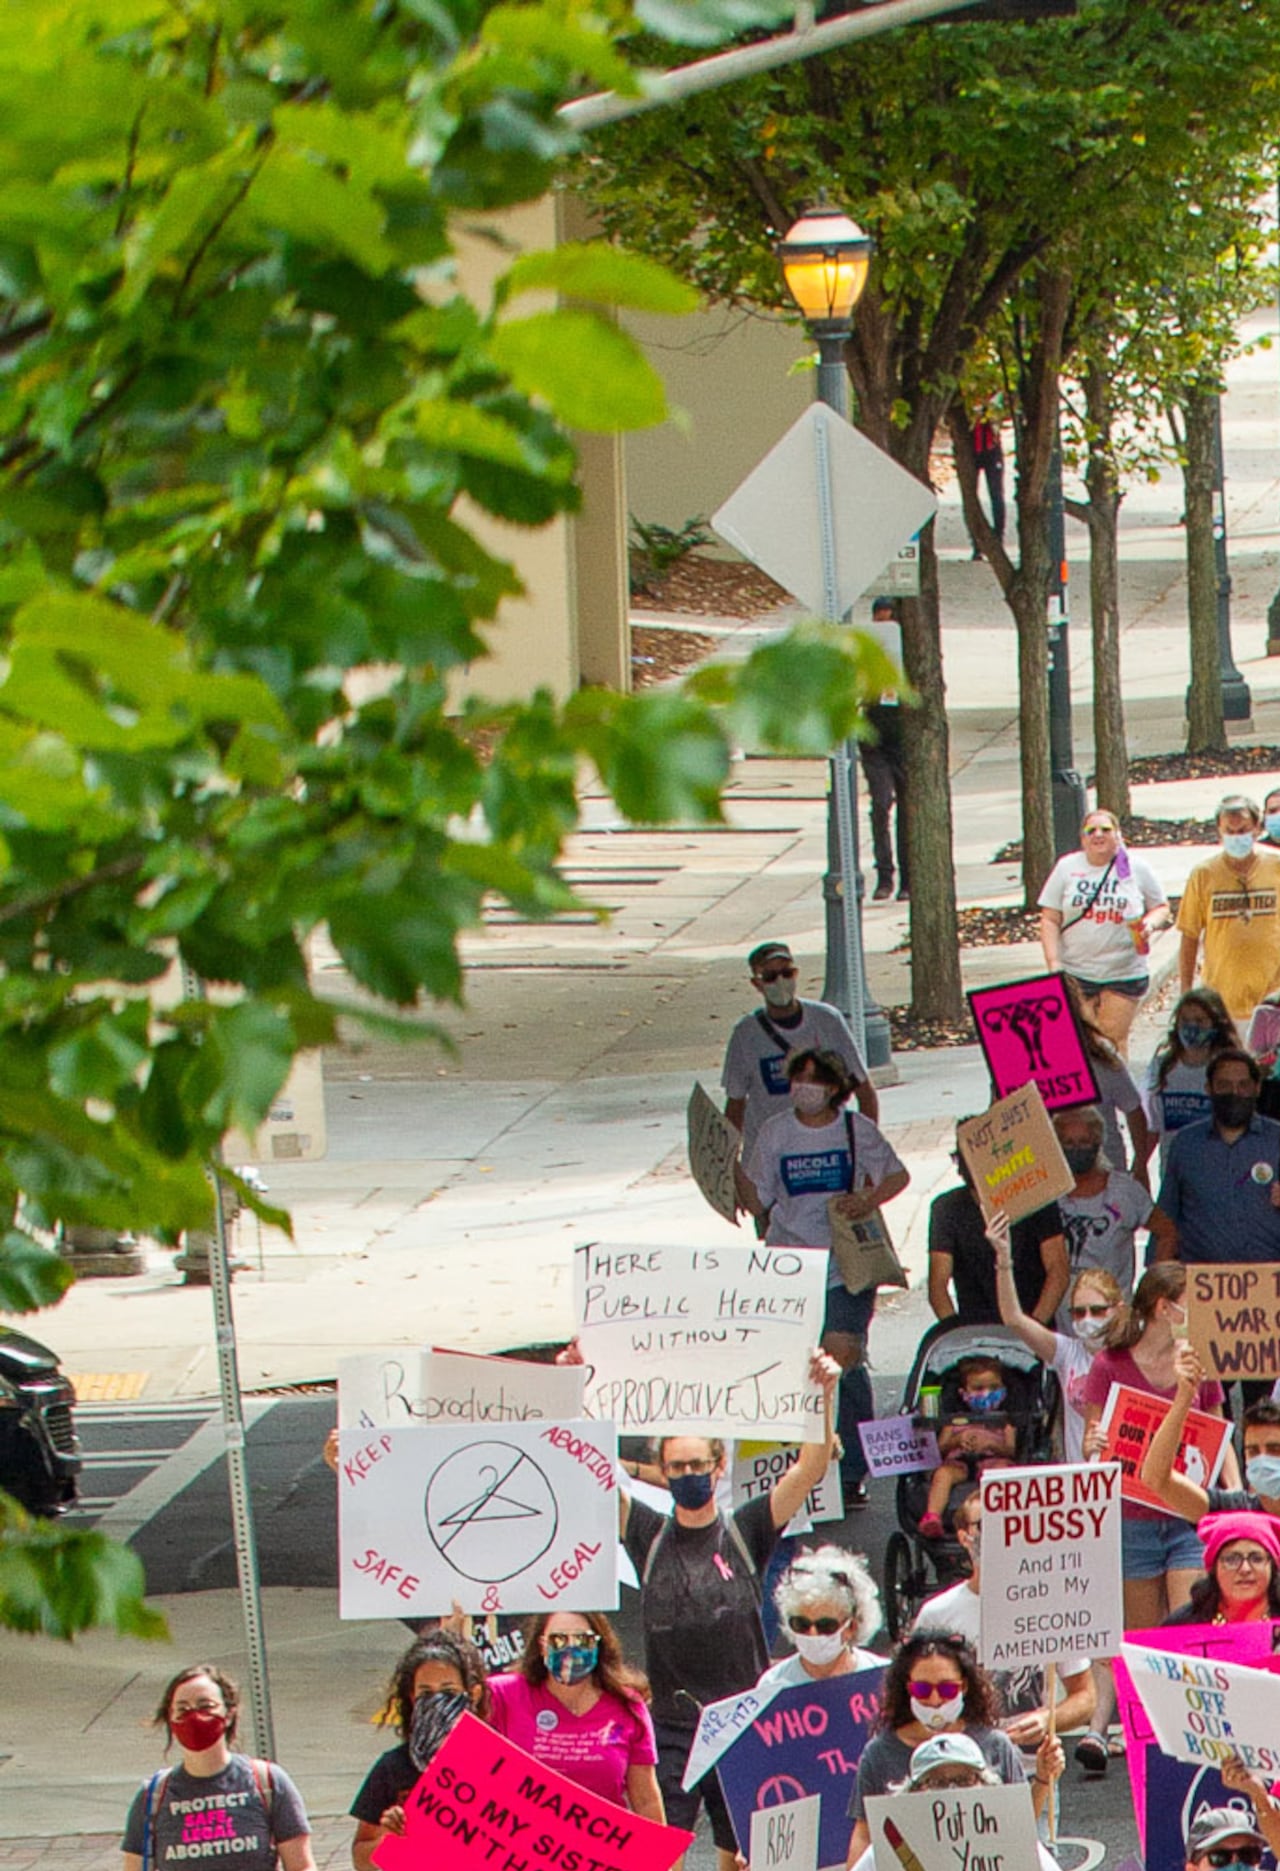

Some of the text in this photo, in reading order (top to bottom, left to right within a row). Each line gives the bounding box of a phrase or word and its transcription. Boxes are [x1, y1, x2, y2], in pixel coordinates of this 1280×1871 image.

[574, 1242, 803, 1280] THERE IS NO
[1195, 1270, 1258, 1301] STOP
[583, 1285, 807, 1322] PUBLIC HEALTH
[1215, 1307, 1270, 1334] WAR
[632, 1328, 760, 1351] WITHOUT
[735, 1361, 826, 1424] JUSTICE
[984, 1468, 1119, 1513] GRAB MY
[1004, 1506, 1108, 1547] PUSSY
[1018, 1555, 1053, 1575] And
[1006, 1576, 1090, 1601] Grab My
[1014, 1610, 1092, 1634] SECOND
[992, 1631, 1111, 1660] AMENDMENT
[170, 1792, 249, 1815] PROTECT
[435, 1767, 476, 1804] SO
[480, 1801, 531, 1838] MY
[489, 1756, 633, 1850] I MARCH
[182, 1825, 237, 1843] LEGAL
[415, 1787, 507, 1861] WON'T
[932, 1800, 998, 1842] Put On
[165, 1835, 258, 1860] ABORTION
